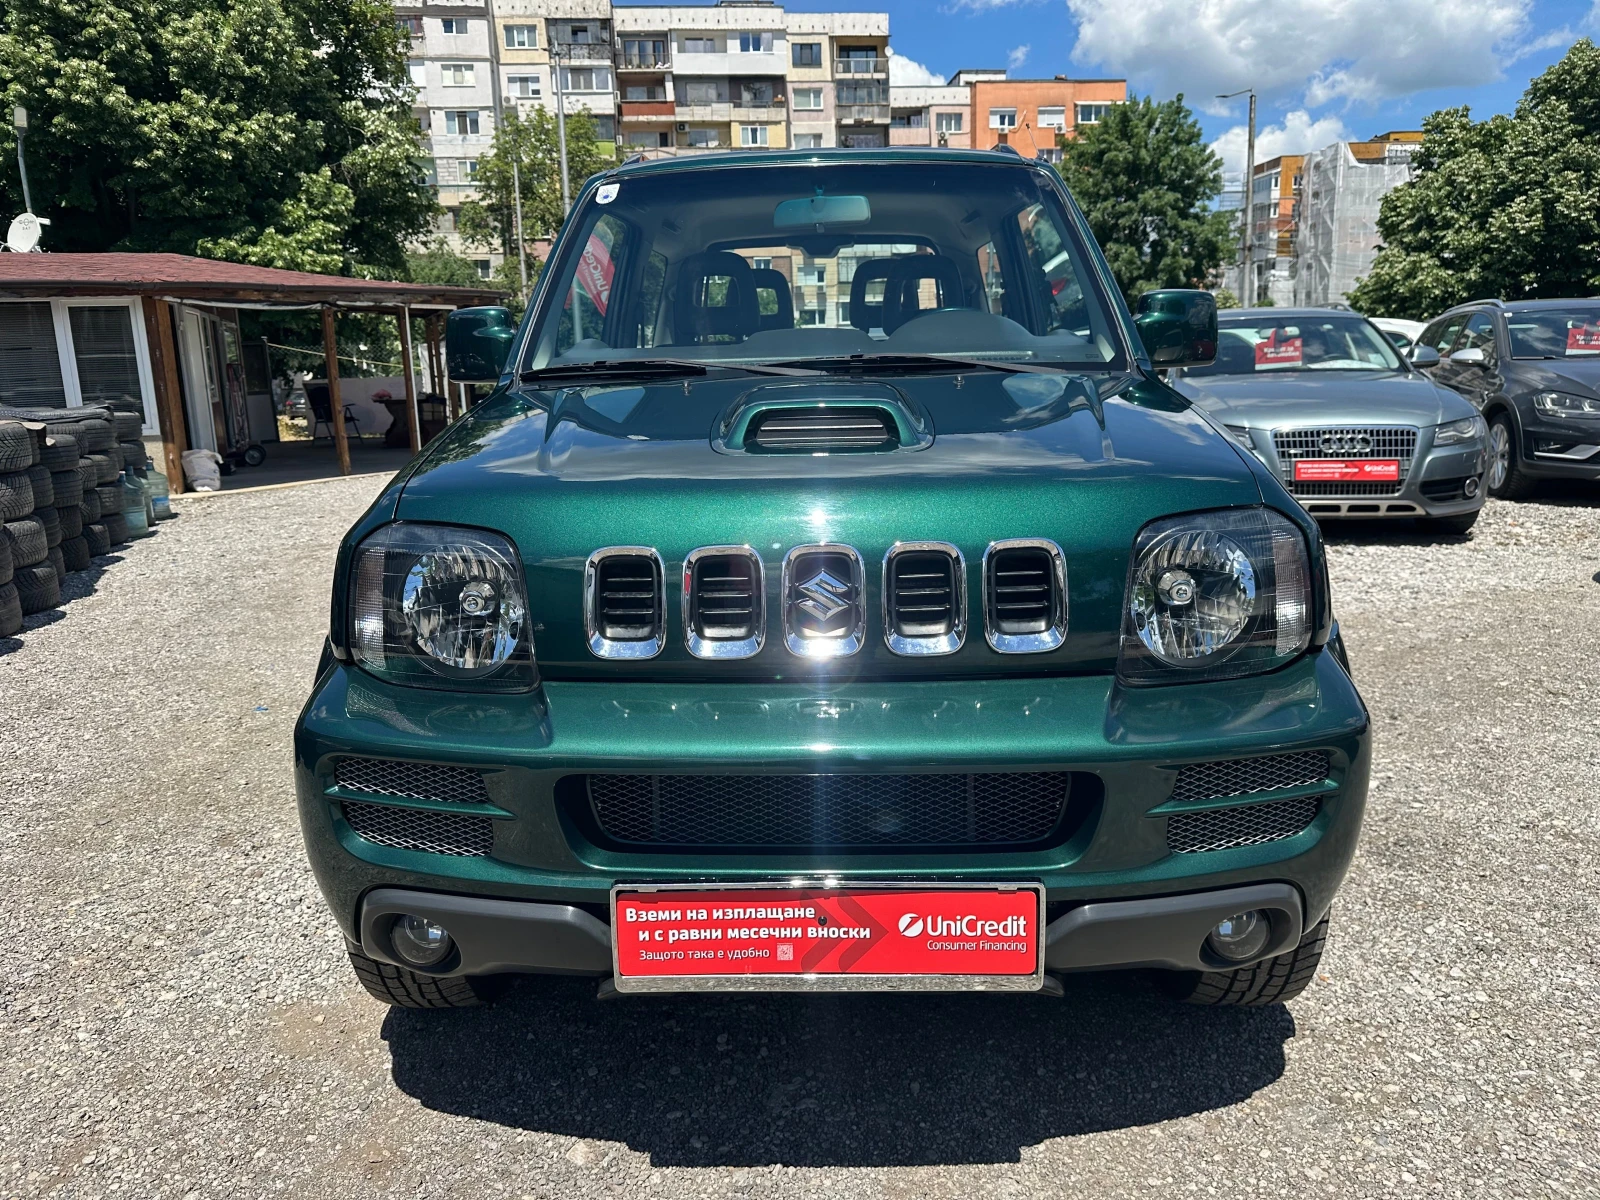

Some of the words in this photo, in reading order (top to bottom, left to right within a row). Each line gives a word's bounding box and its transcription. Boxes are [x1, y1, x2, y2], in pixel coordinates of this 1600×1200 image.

[625, 907, 682, 922] Вземи
[686, 908, 708, 921] на
[712, 906, 815, 922] изплащане
[926, 914, 1027, 938] UniCredit
[638, 929, 650, 942] и
[654, 929, 664, 941] с
[668, 928, 722, 944] равни
[727, 926, 802, 940] месечни
[807, 926, 871, 939] вноски
[639, 949, 684, 961] Защото
[688, 949, 714, 960] така
[717, 950, 724, 959] е
[727, 947, 770, 961] удобно
[926, 940, 978, 950] Consumer
[979, 939, 1027, 953] Financing
